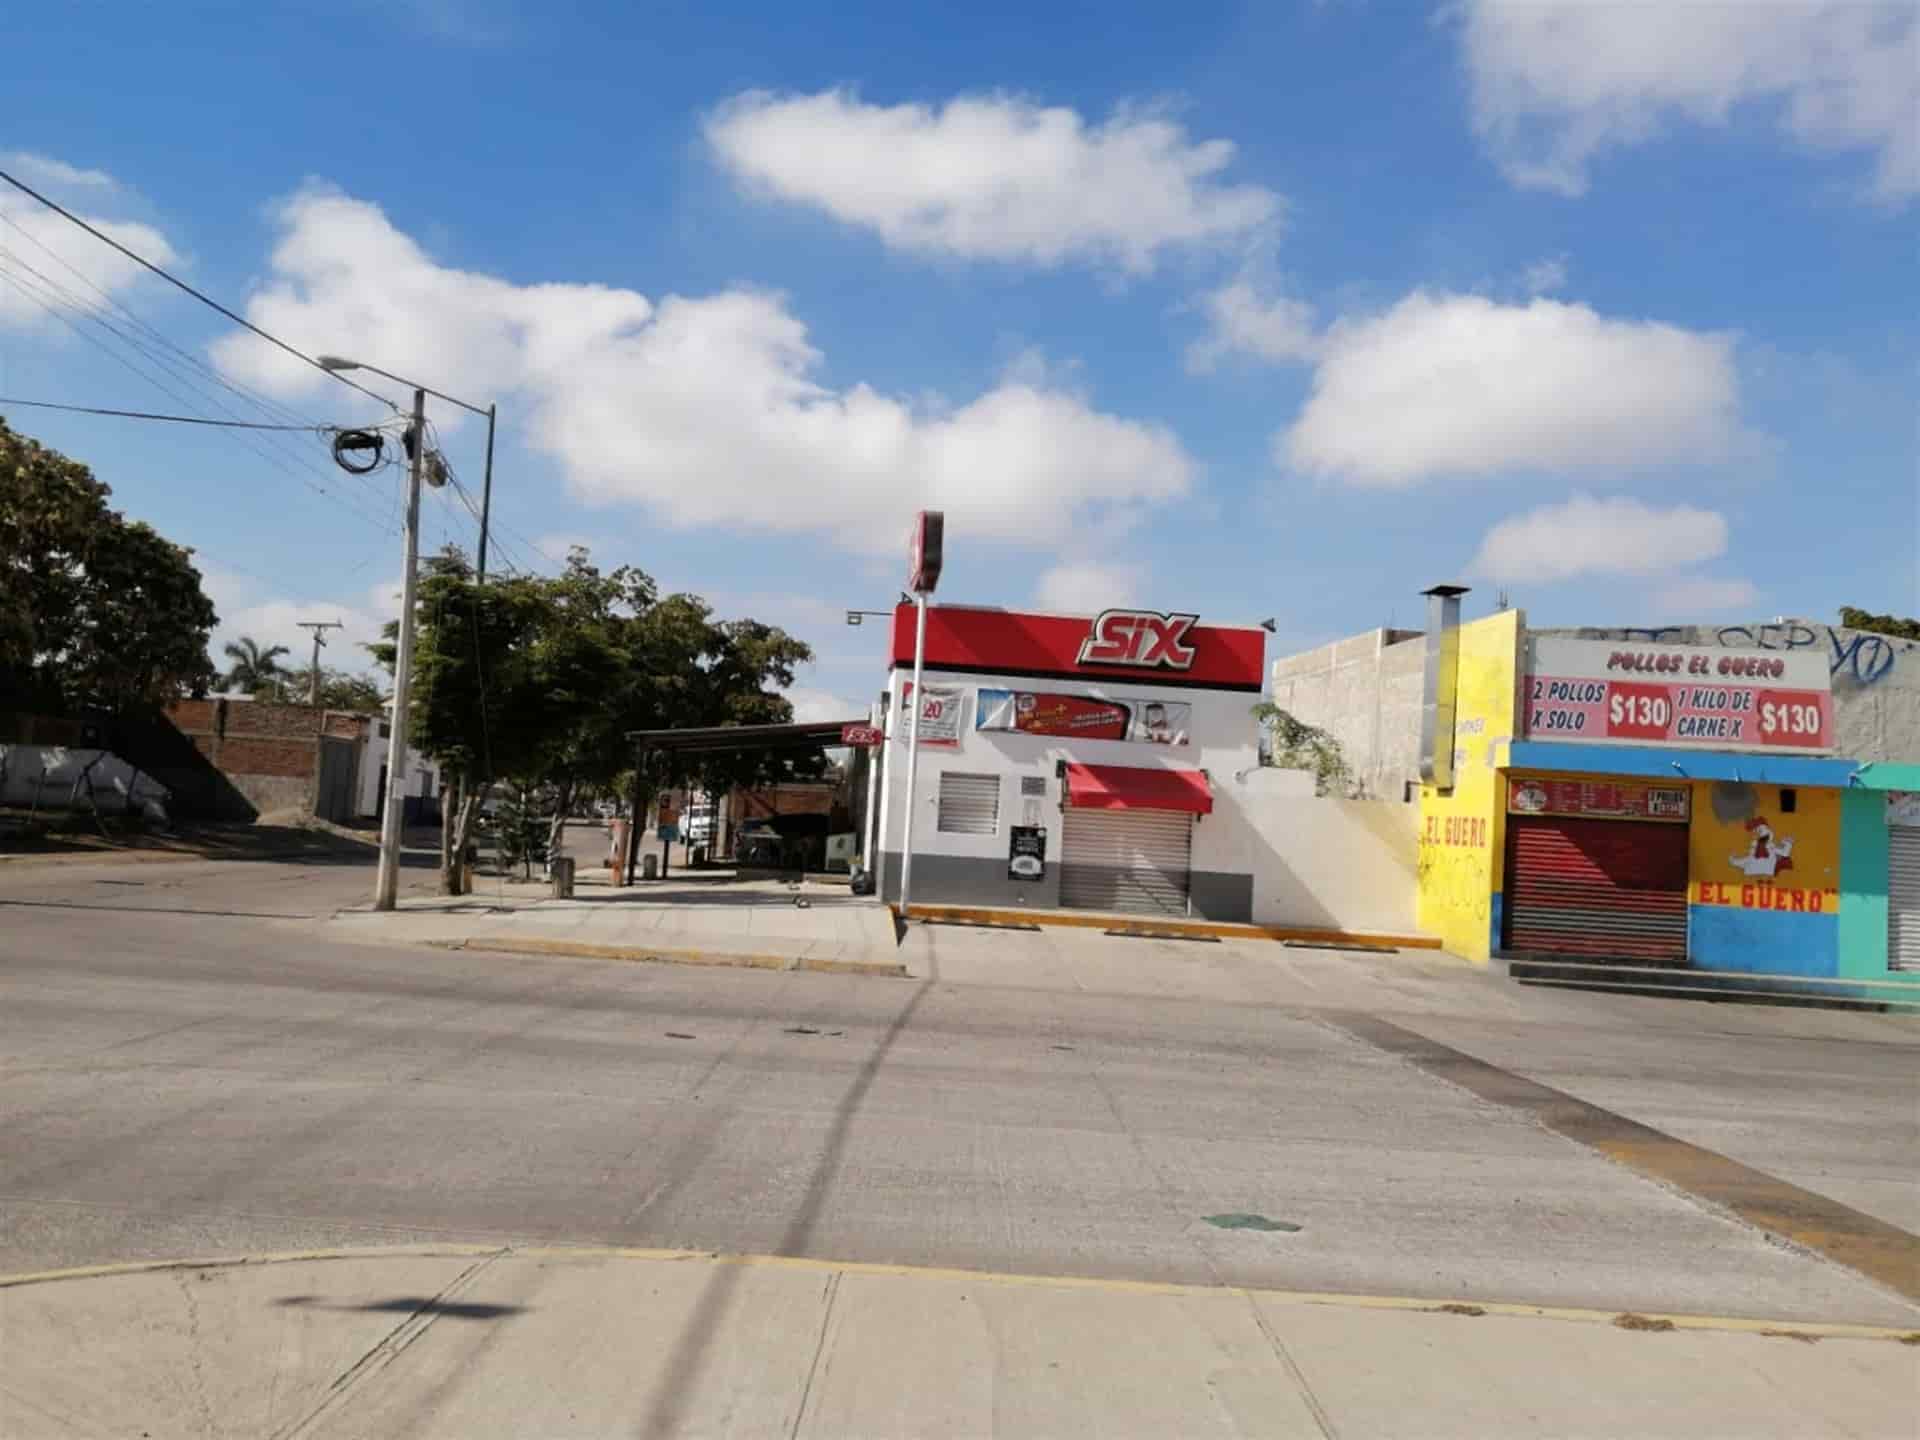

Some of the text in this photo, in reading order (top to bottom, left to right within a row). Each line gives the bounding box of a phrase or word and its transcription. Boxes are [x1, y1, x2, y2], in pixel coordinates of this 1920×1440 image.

[1607, 651, 1683, 673] POLLOS
[1688, 655, 1710, 675] EL
[1533, 681, 1605, 702] 2 POLLOS
[1679, 689, 1751, 710] 1 KILO DE
[1532, 709, 1585, 731] X SOLO
[1610, 692, 1666, 727] $130
[1762, 701, 1820, 735] $130
[1678, 716, 1742, 737] CARNE X
[1427, 815, 1440, 844] EL
[1700, 881, 1730, 904] EL
